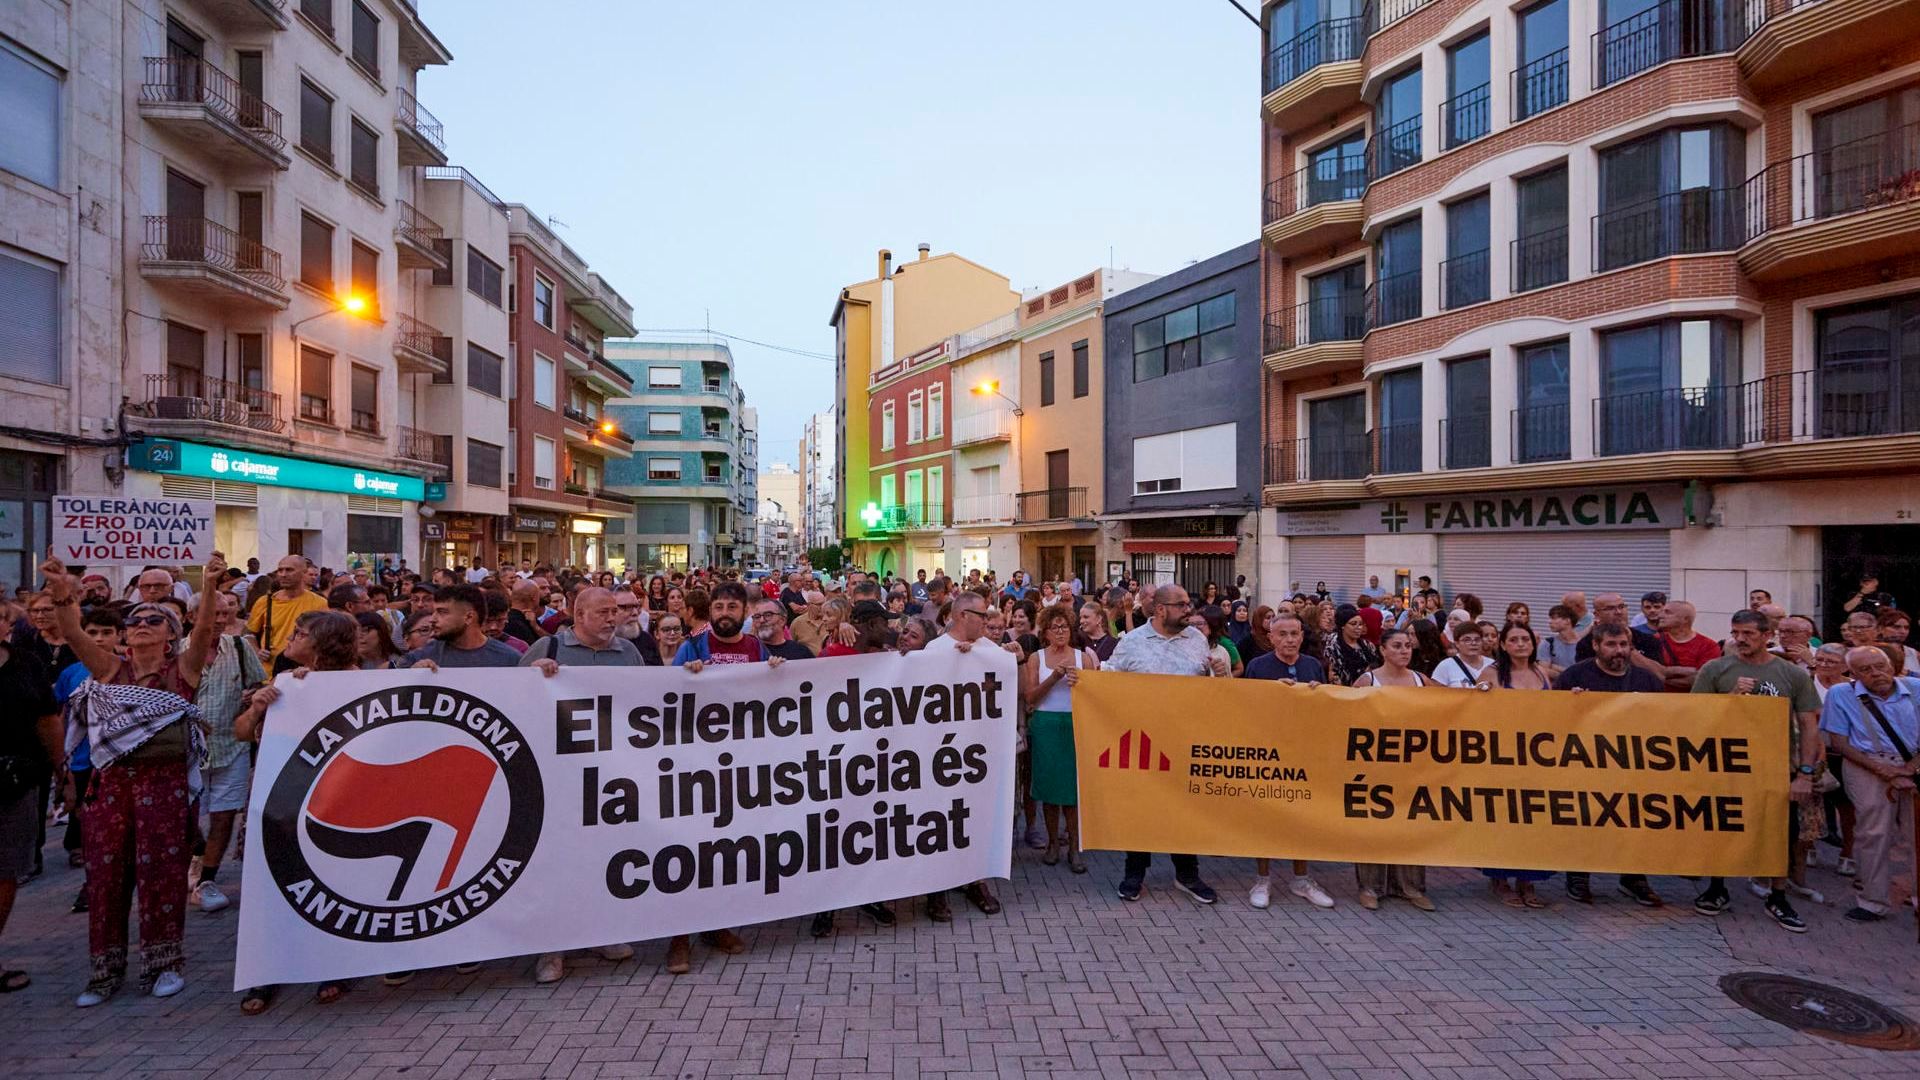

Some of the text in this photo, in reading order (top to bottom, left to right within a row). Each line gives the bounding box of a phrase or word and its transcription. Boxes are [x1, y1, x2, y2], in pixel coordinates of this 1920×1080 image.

[230, 457, 280, 477] cajamar
[57, 498, 193, 516] TOLERÀNCIA
[1424, 491, 1660, 530] FARMACIA
[1896, 510, 1912, 519] 21
[63, 515, 210, 532] ZERO DAVANT
[153, 531, 159, 545] I
[168, 531, 197, 546] LA
[68, 543, 194, 560] VIOLÈNCIA
[555, 672, 1003, 755] El silenci davant
[299, 692, 521, 767] LA VALLDIGNA
[1191, 744, 1281, 762] ESQUERRA
[1346, 728, 1752, 774] REPUBLICANISME
[582, 733, 988, 829] la injustícia és
[1190, 763, 1308, 782] REPUBLICANA
[1188, 780, 1312, 803] la Safor-Valldigna
[1343, 774, 1746, 832] ÉS ANTIFEIXISME
[605, 798, 970, 900] complicitat
[286, 857, 522, 937] ANTIFEIXISTA
